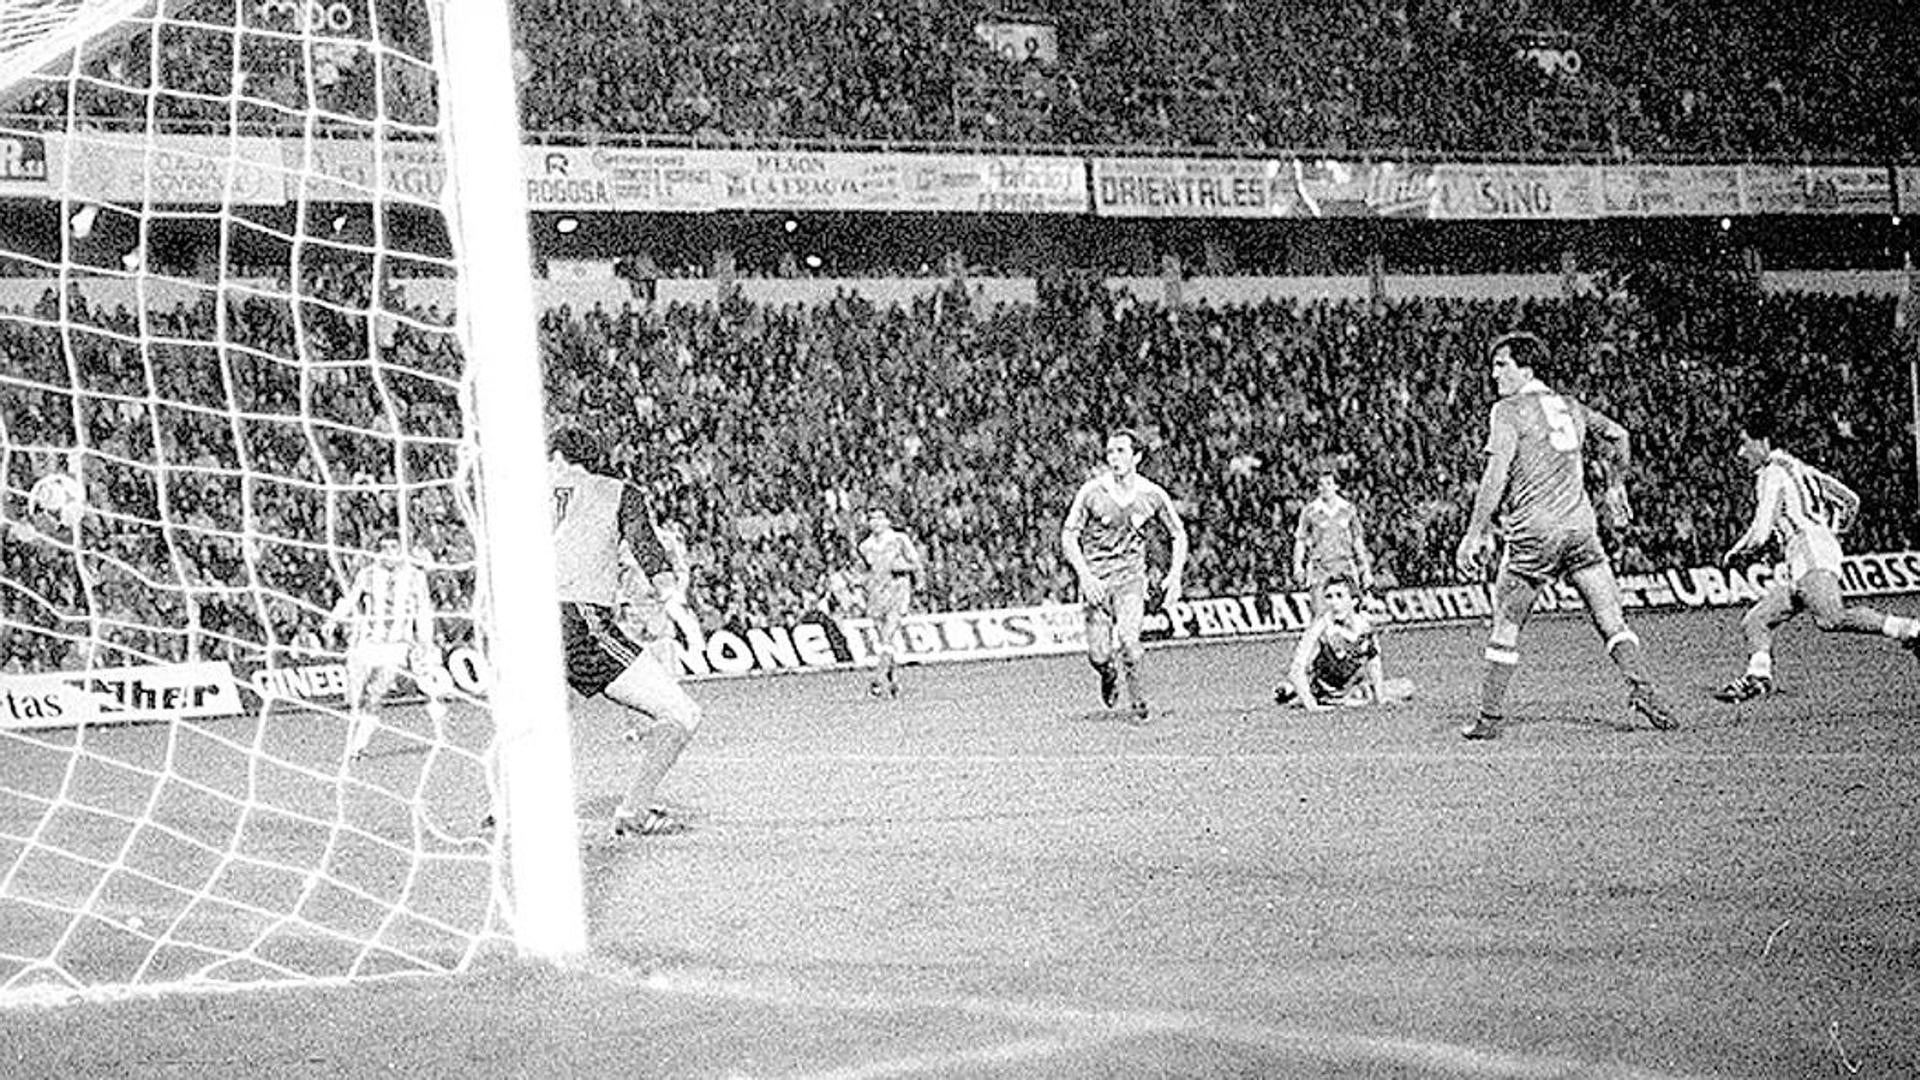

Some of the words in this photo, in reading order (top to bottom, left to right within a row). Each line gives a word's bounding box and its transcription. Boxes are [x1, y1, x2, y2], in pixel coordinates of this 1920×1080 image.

[1101, 176, 1267, 210] ORIENTALES
[1539, 395, 1579, 452] 5
[251, 664, 347, 699] GINEB
[0, 689, 65, 719] tas
